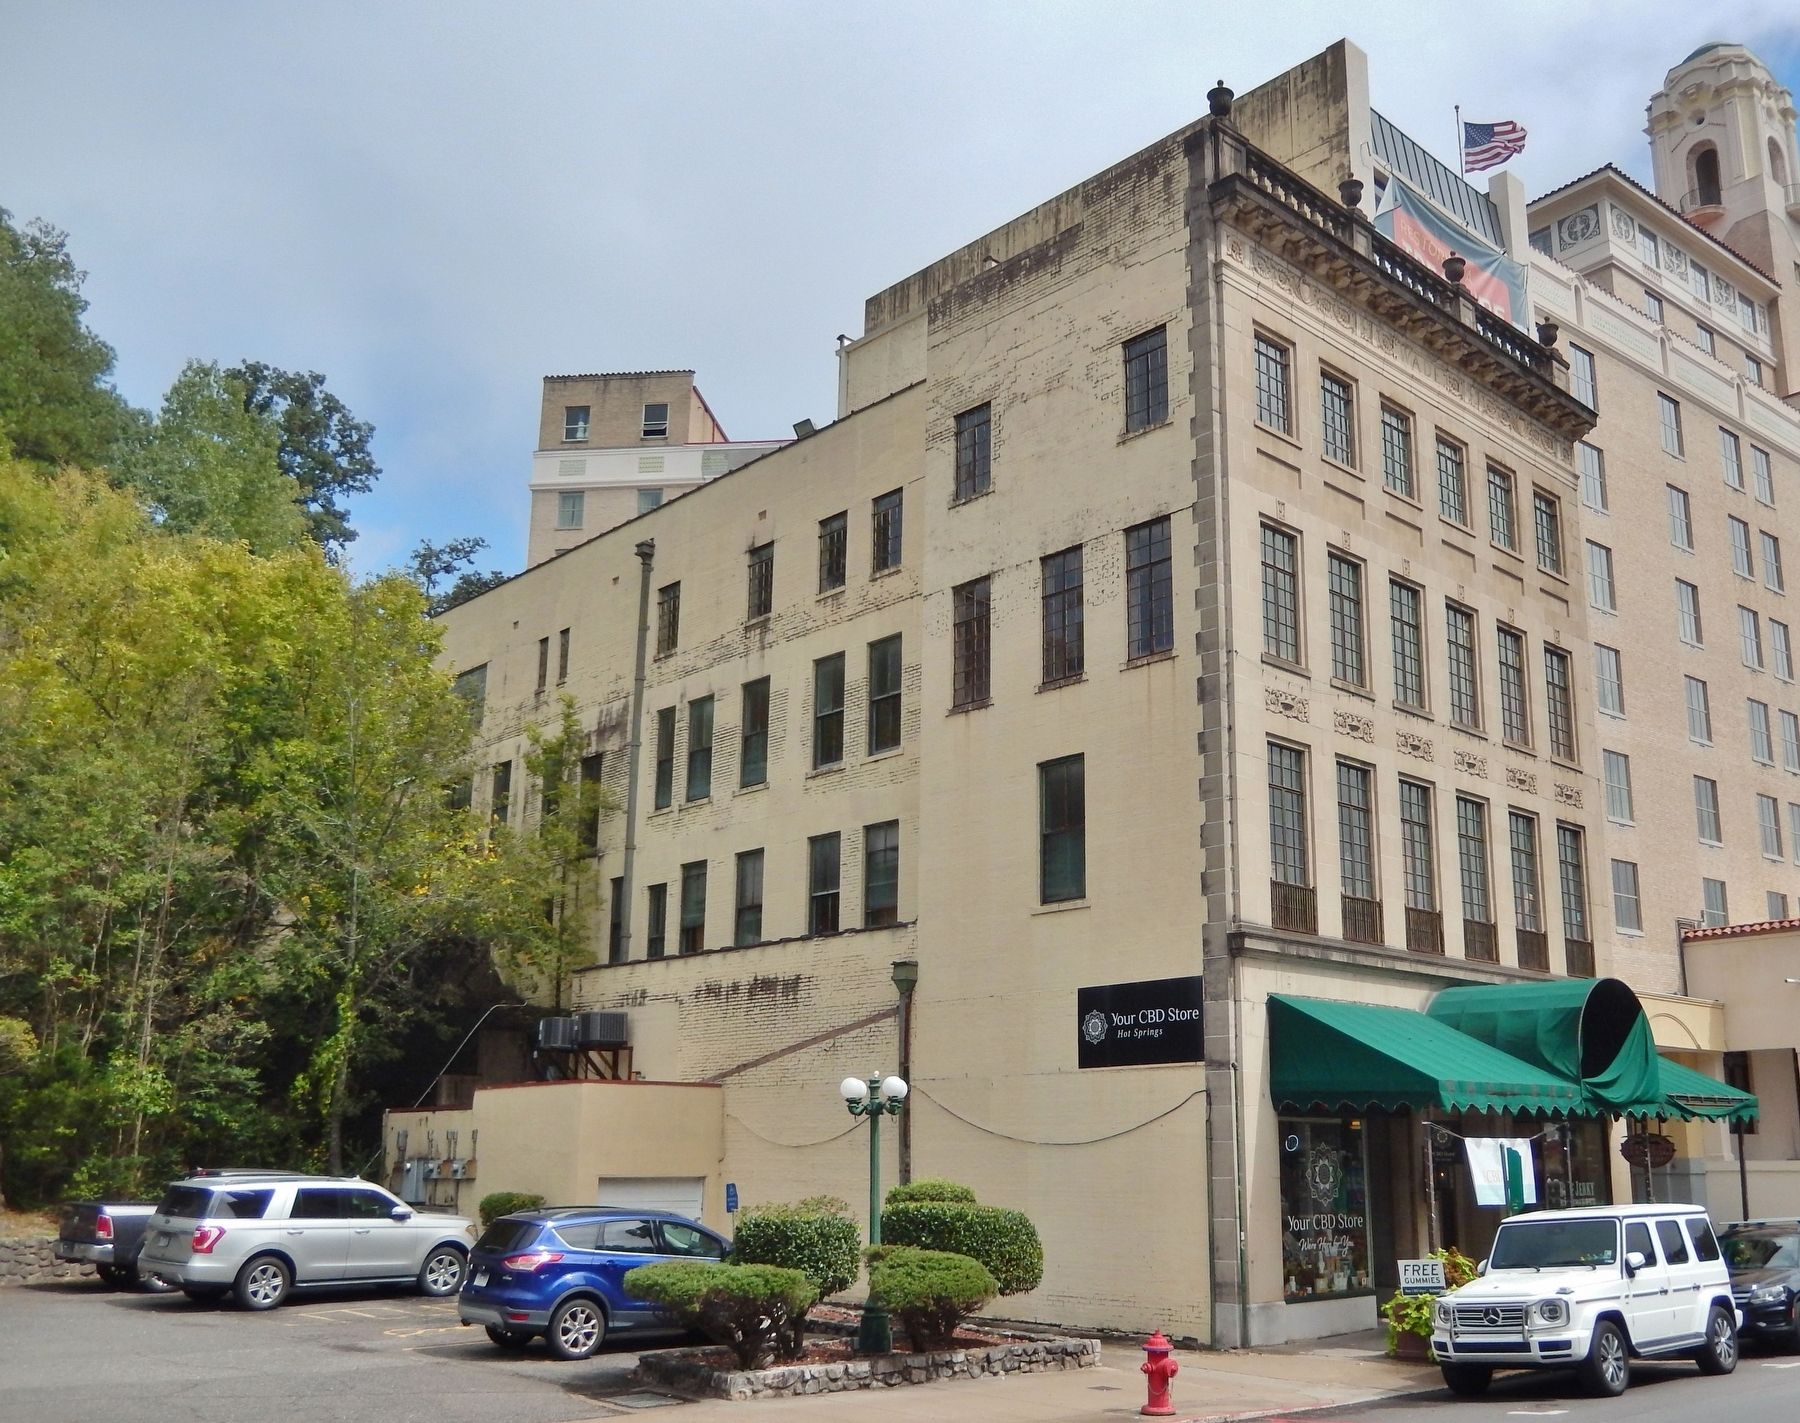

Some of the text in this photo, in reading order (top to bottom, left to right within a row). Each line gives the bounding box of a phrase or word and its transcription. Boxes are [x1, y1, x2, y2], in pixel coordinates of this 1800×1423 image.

[1111, 1007, 1199, 1026] Your CBD Store
[1117, 1028, 1163, 1039] Hot Springs
[1288, 1213, 1363, 1231] Your CBD Store
[1404, 1263, 1439, 1276] FREE
